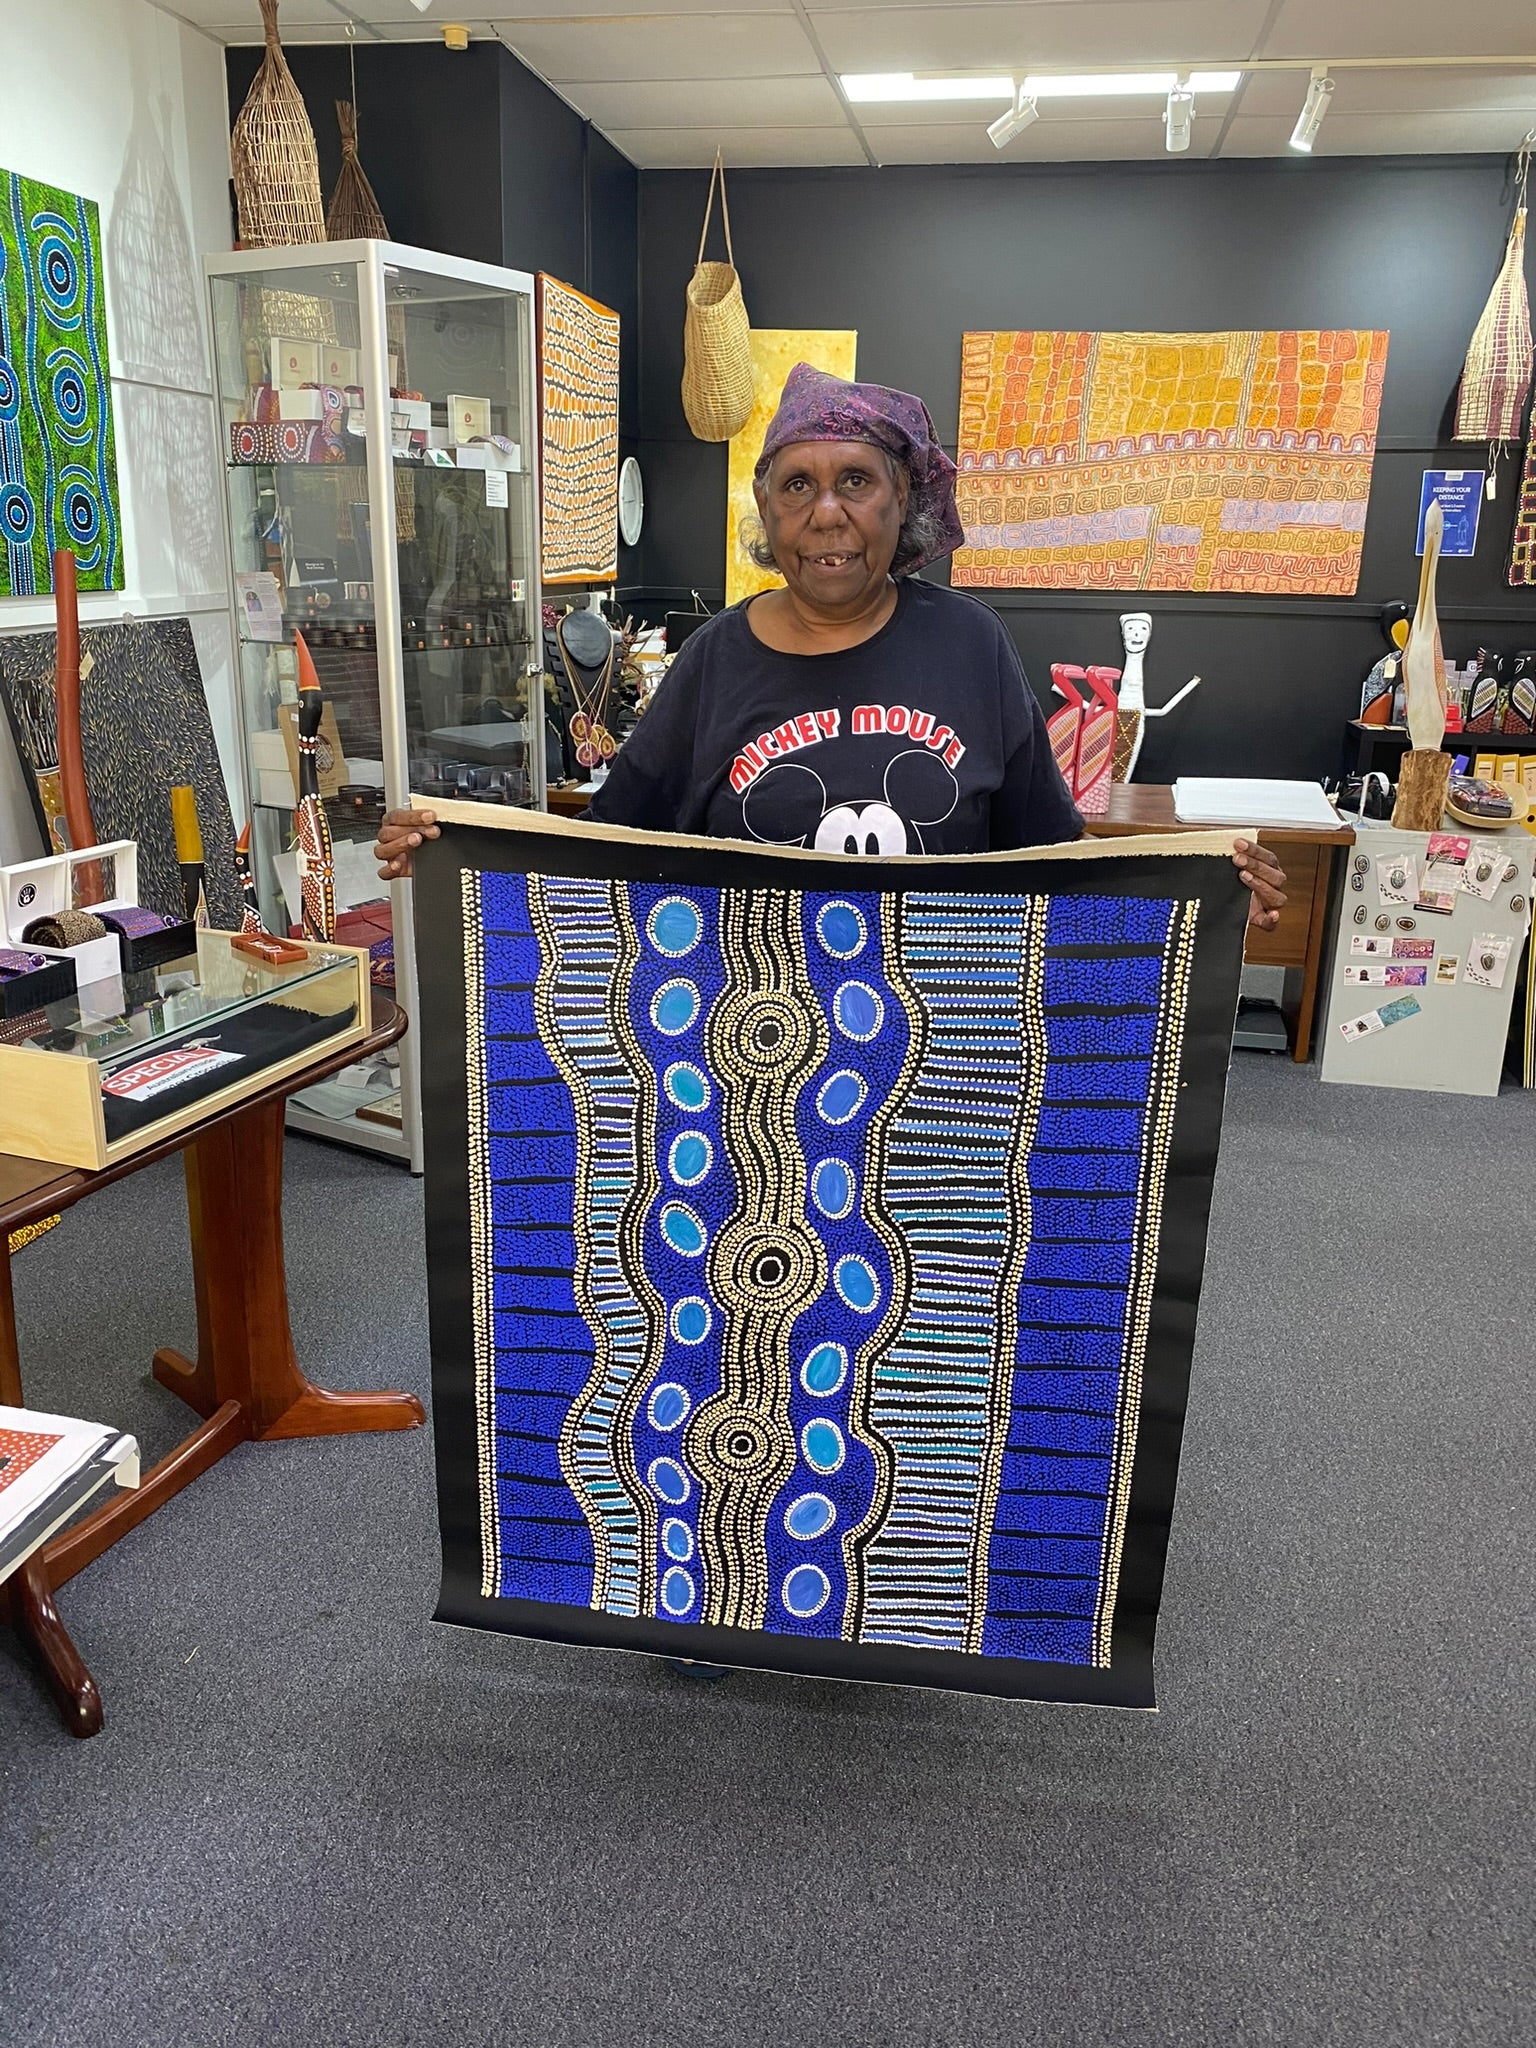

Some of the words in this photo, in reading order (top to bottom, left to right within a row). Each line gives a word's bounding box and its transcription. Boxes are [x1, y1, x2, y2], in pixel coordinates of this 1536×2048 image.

[729, 708, 841, 795] MICKEY
[852, 704, 967, 770] MOUSE
[106, 1050, 211, 1091] SPECIAL
